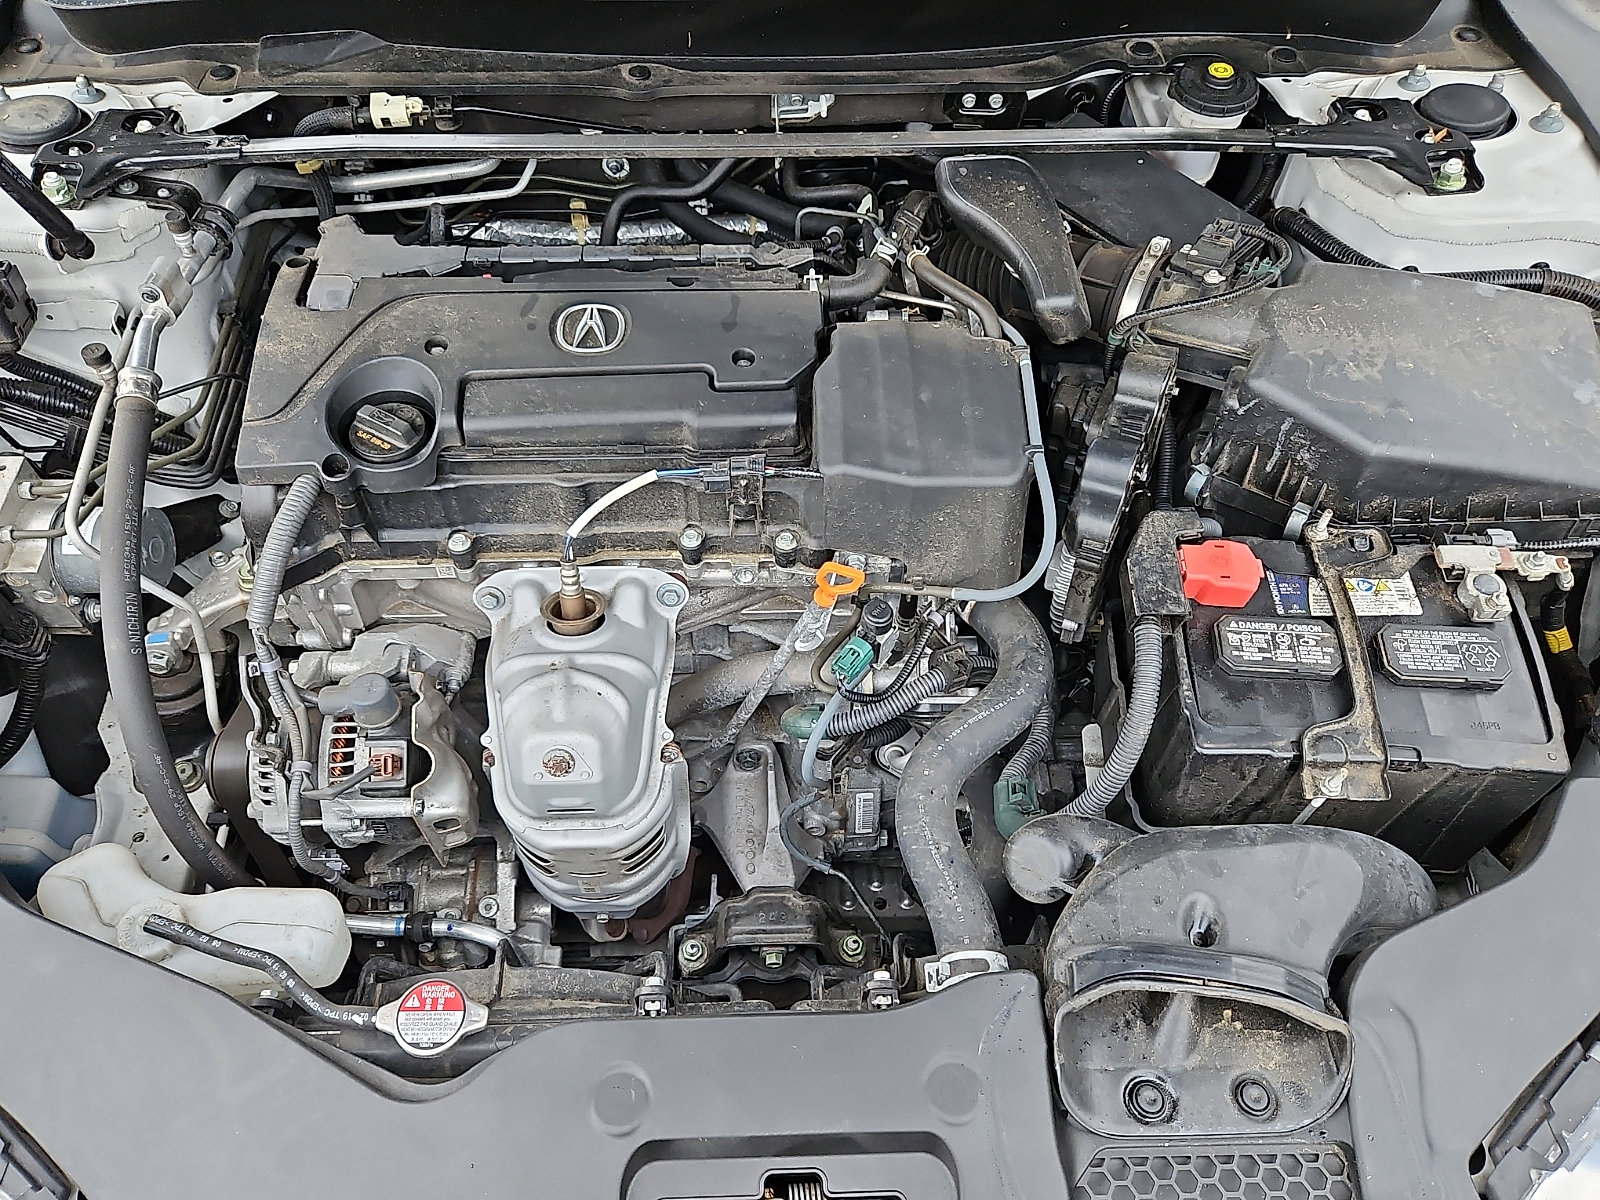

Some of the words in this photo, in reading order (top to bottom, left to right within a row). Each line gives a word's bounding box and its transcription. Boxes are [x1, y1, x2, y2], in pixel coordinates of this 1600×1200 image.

[1239, 621, 1277, 631] DANGER
[1286, 624, 1322, 633] POISON
[170, 923, 187, 933] TPC
[262, 955, 276, 966] TPC
[422, 984, 450, 992] DANGER
[323, 1008, 340, 1020] TPC
